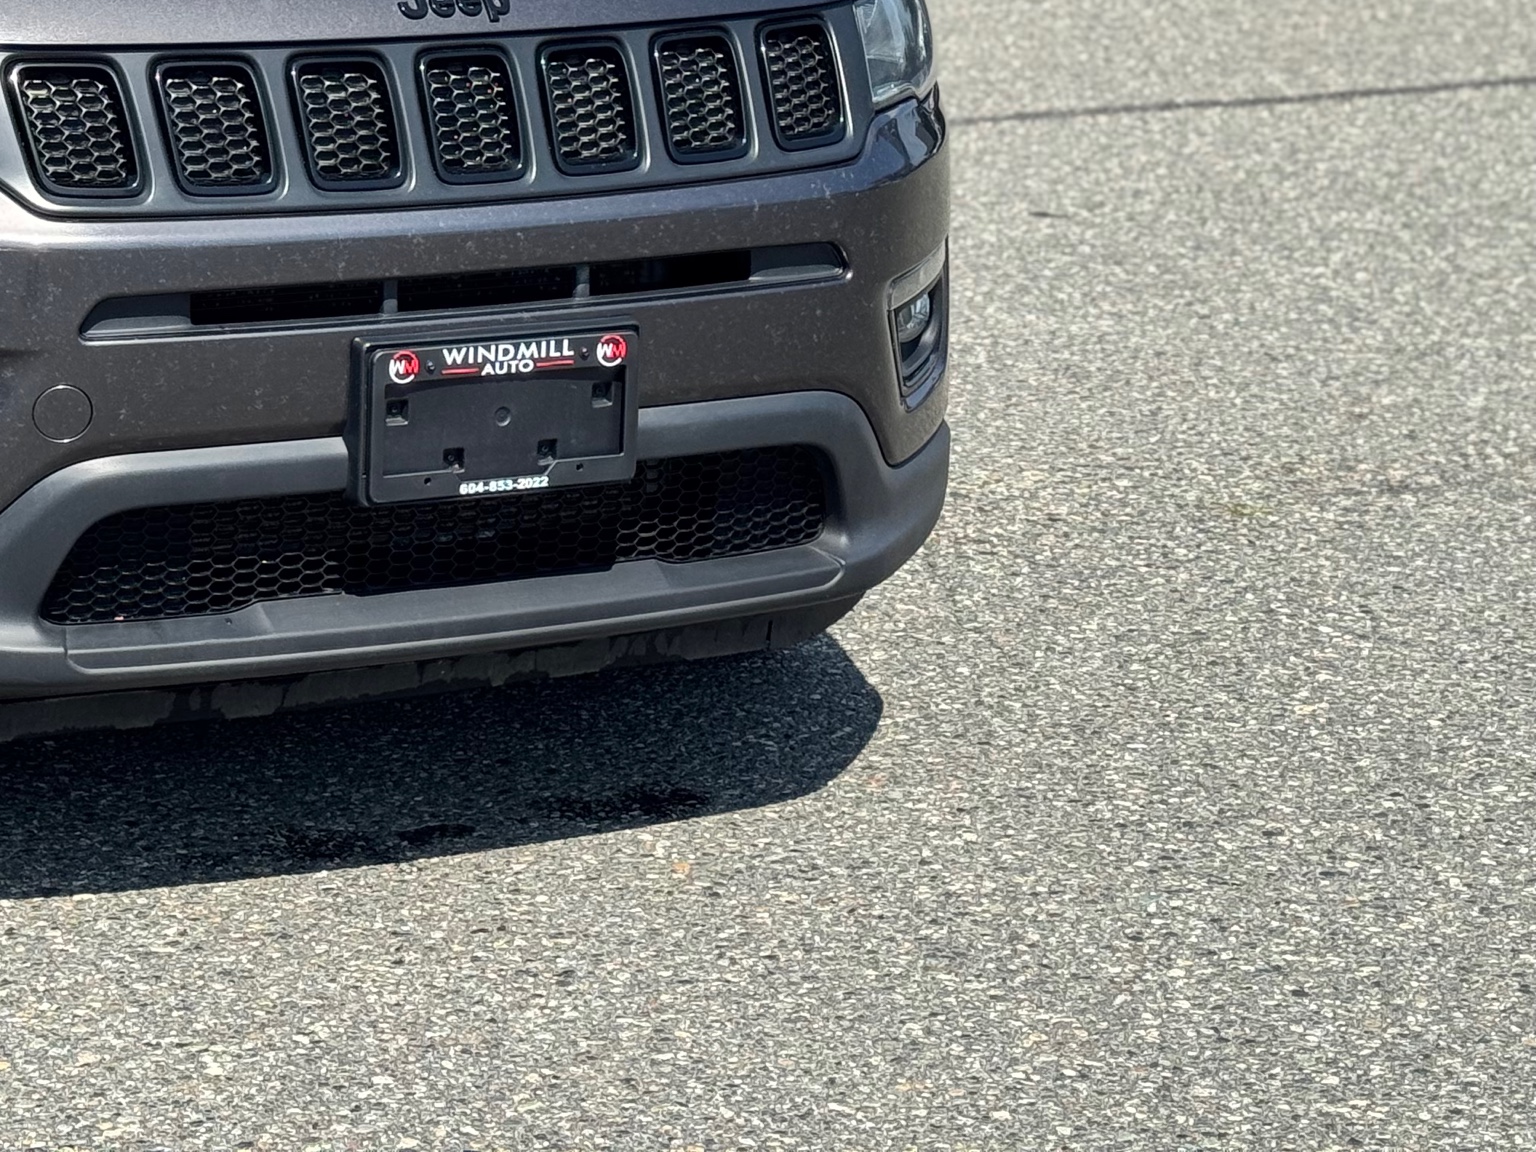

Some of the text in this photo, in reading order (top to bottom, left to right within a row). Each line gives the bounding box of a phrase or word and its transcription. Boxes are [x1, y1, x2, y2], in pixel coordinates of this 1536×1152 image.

[442, 339, 574, 365] WINDMILL
[481, 359, 534, 376] AUTO
[459, 475, 549, 495] 604-853-2022
